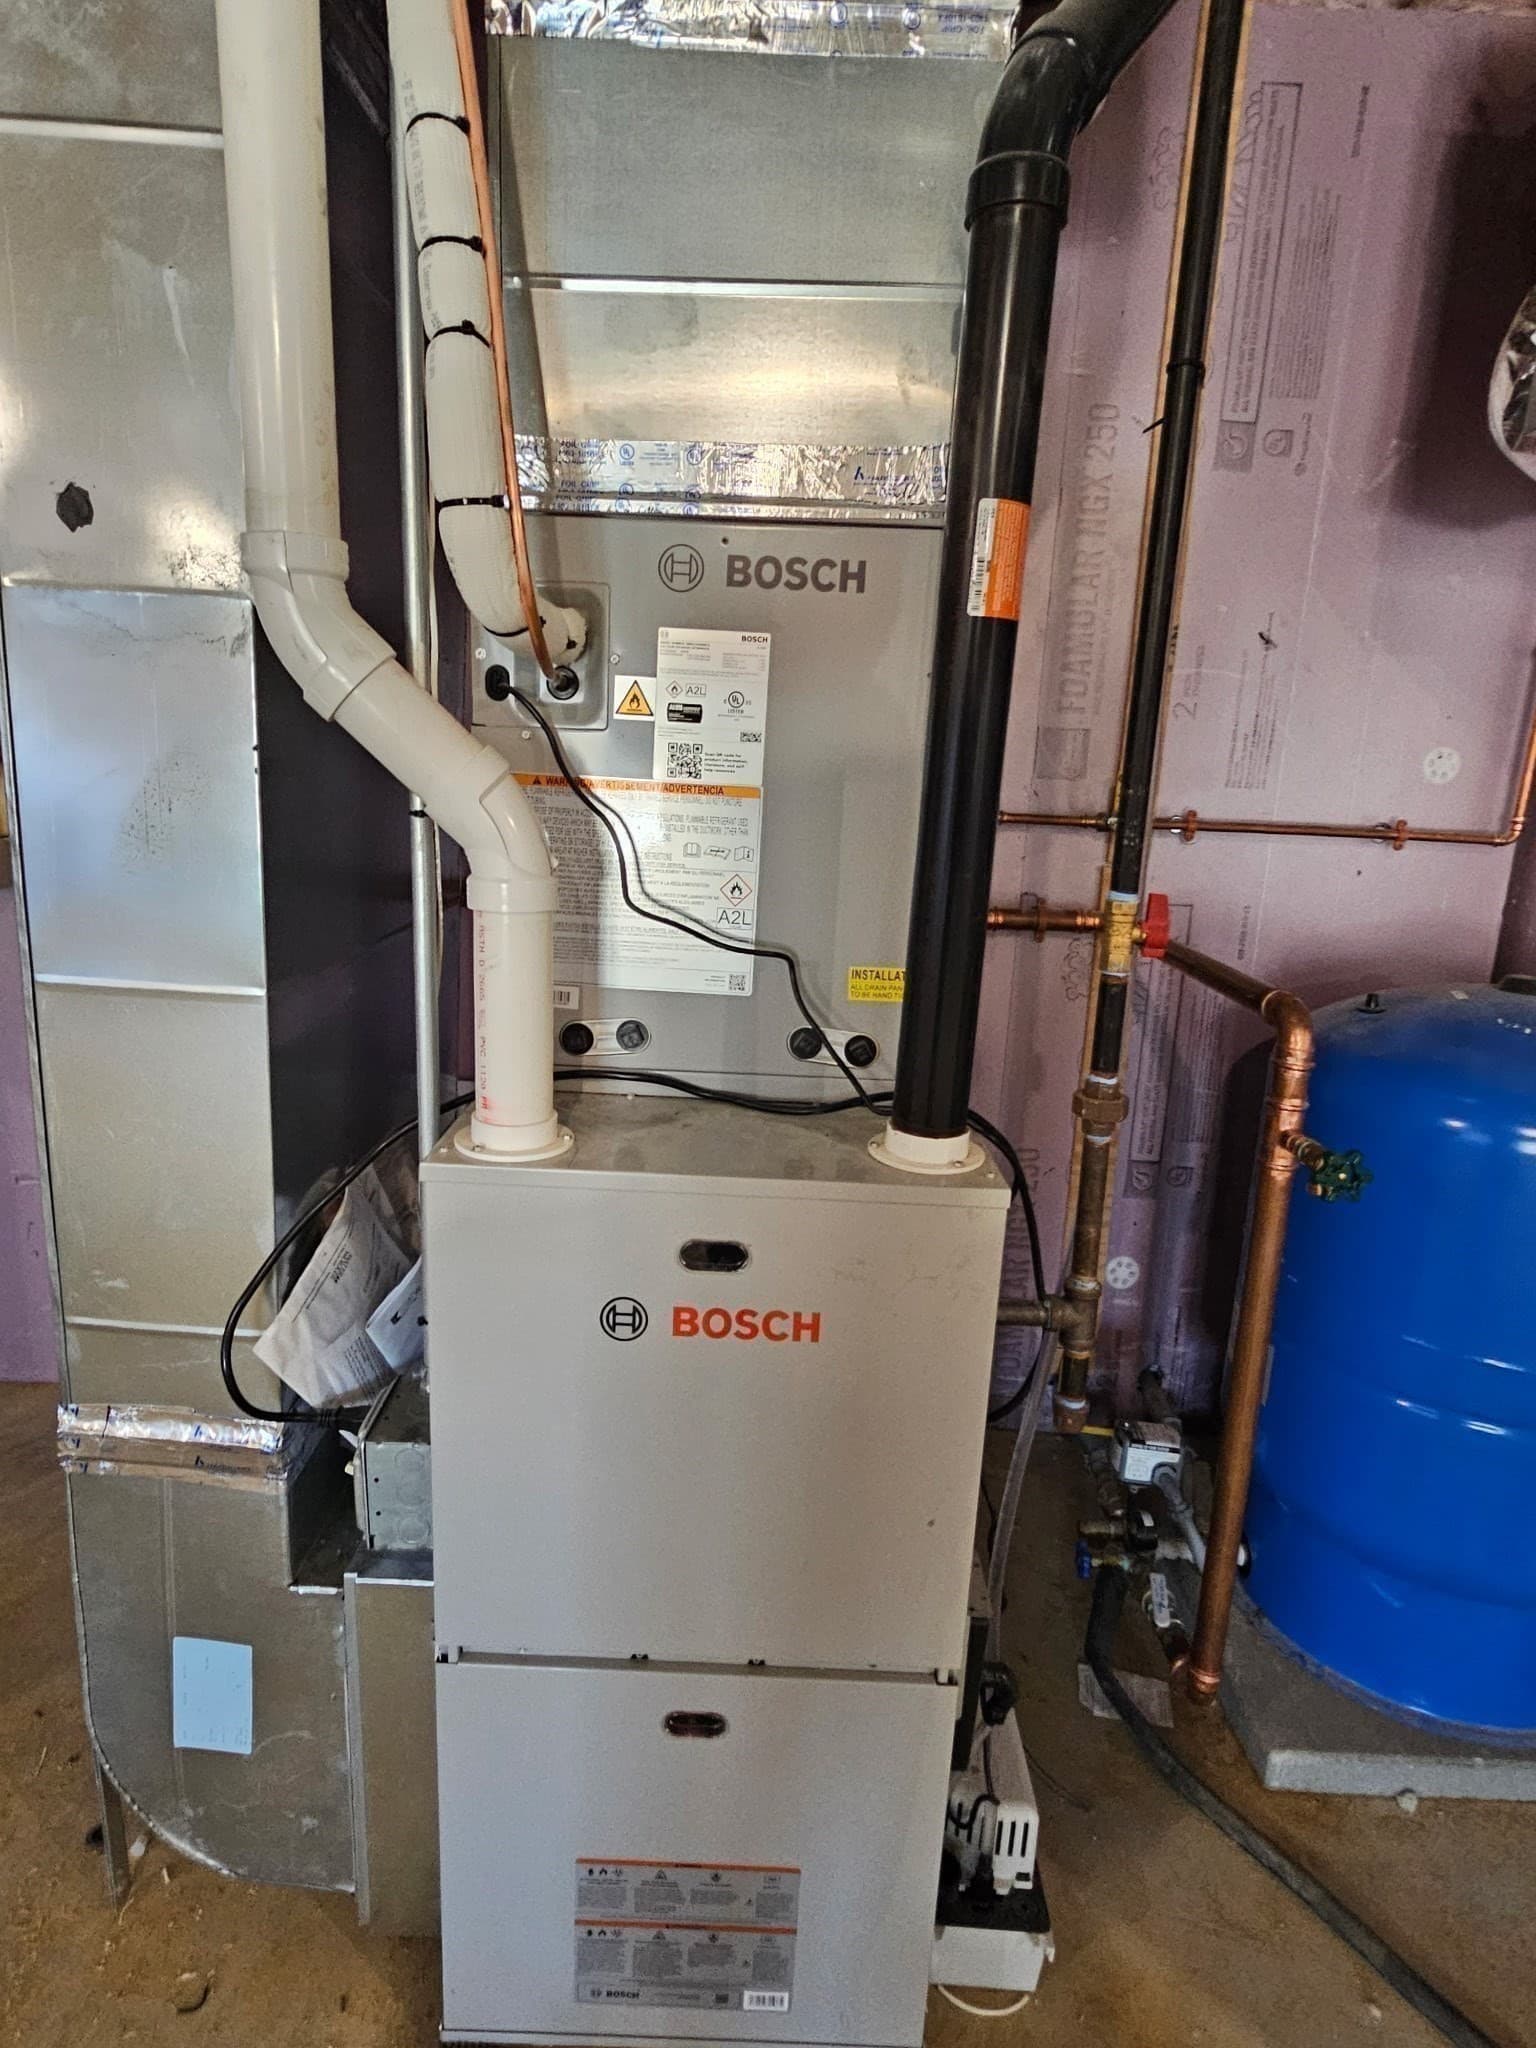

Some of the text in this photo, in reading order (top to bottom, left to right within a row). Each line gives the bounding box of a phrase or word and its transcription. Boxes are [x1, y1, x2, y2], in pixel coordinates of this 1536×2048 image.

[725, 554, 867, 594] BOSCH
[741, 635, 768, 644] BOSCH
[686, 685, 706, 696] A2L
[717, 909, 752, 927] A2L
[672, 1306, 821, 1343] BOSCH
[606, 1989, 641, 2001] BOSCH
